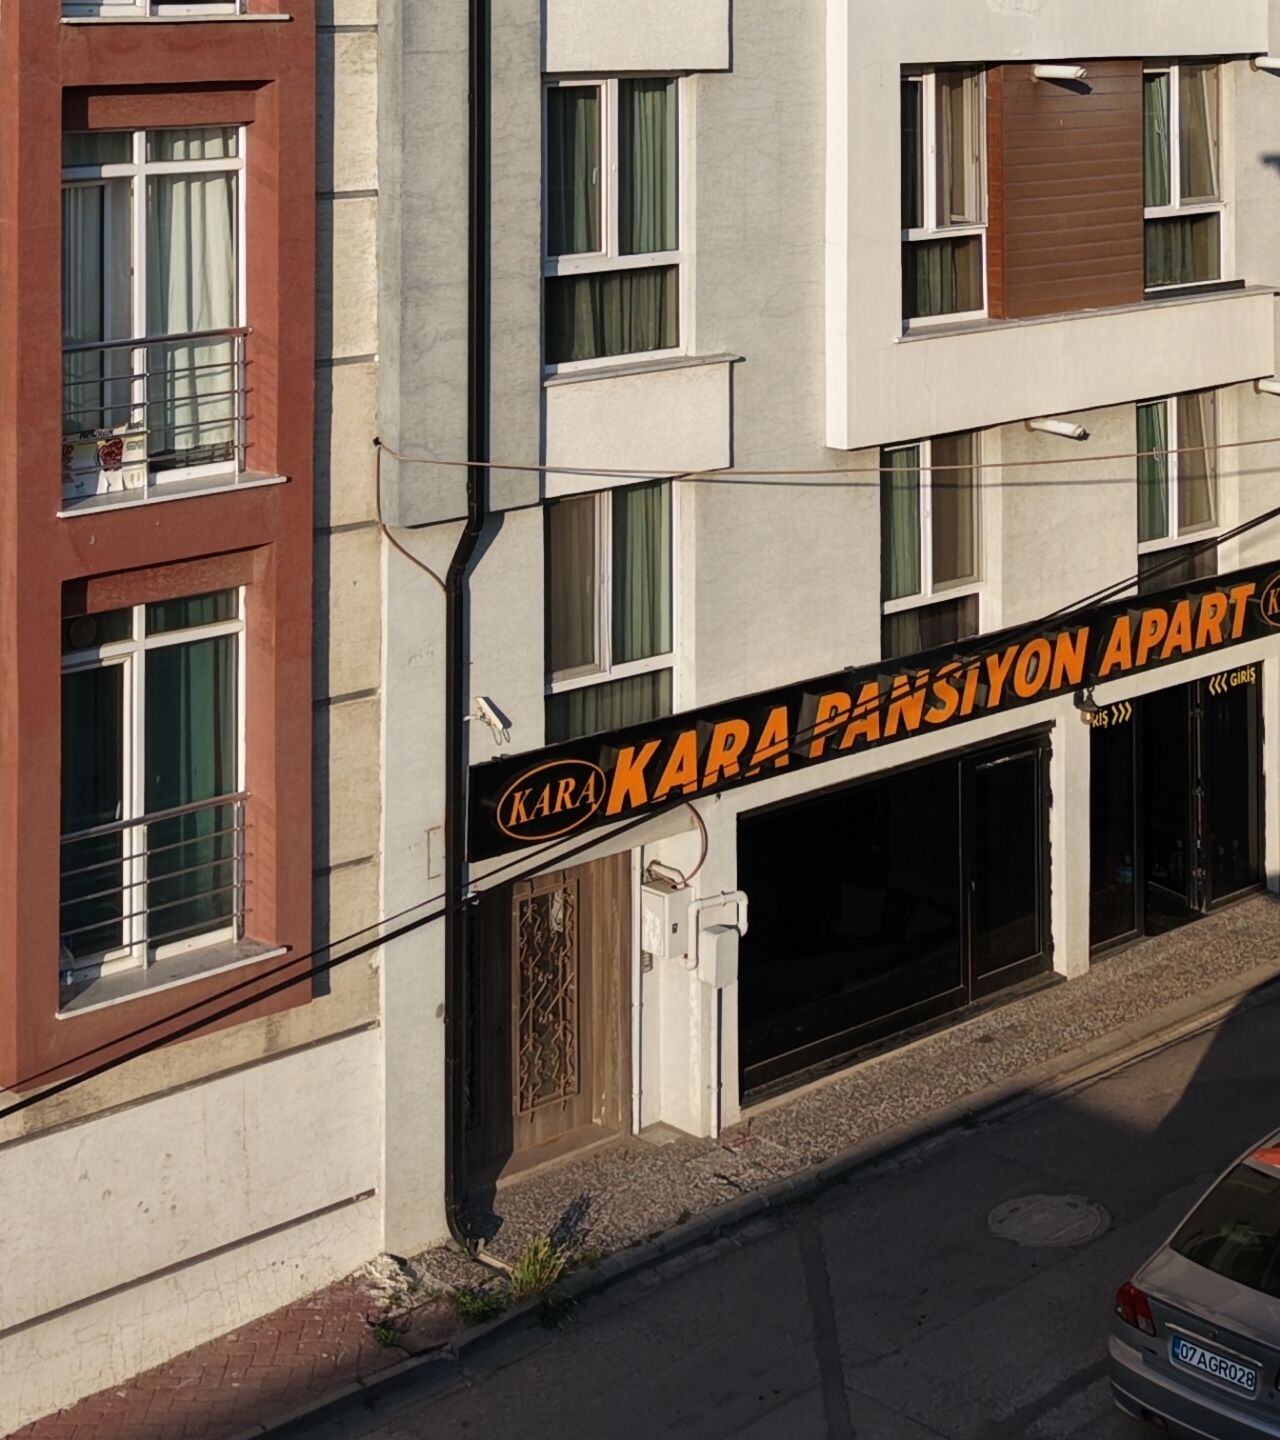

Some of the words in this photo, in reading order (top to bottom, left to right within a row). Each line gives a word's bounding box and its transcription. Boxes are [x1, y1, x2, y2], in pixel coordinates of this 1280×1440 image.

[605, 704, 789, 816] KARA
[1098, 582, 1257, 678] APART
[507, 771, 596, 828] KARA
